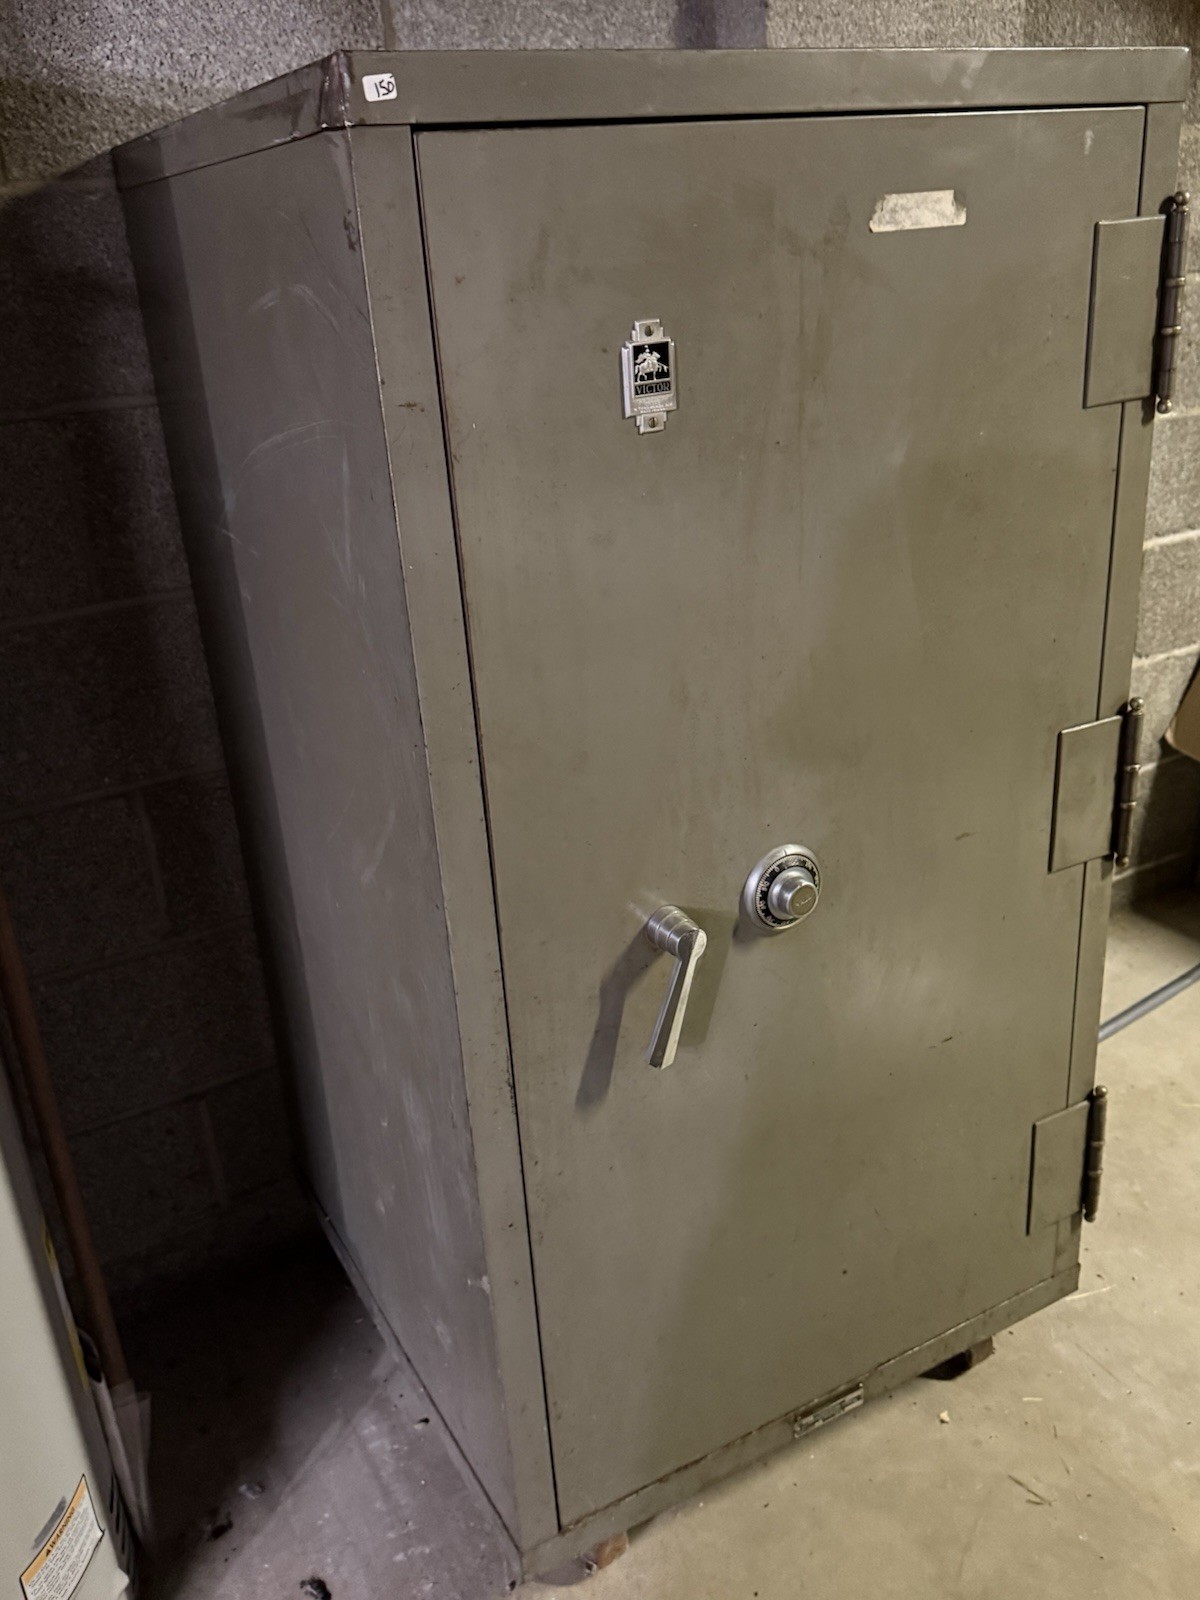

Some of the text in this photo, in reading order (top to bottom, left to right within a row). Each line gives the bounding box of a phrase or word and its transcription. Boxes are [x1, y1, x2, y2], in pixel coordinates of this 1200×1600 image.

[374, 79, 395, 98] 150
[635, 382, 670, 395] VICTOR
[49, 1506, 75, 1549] WARNING
